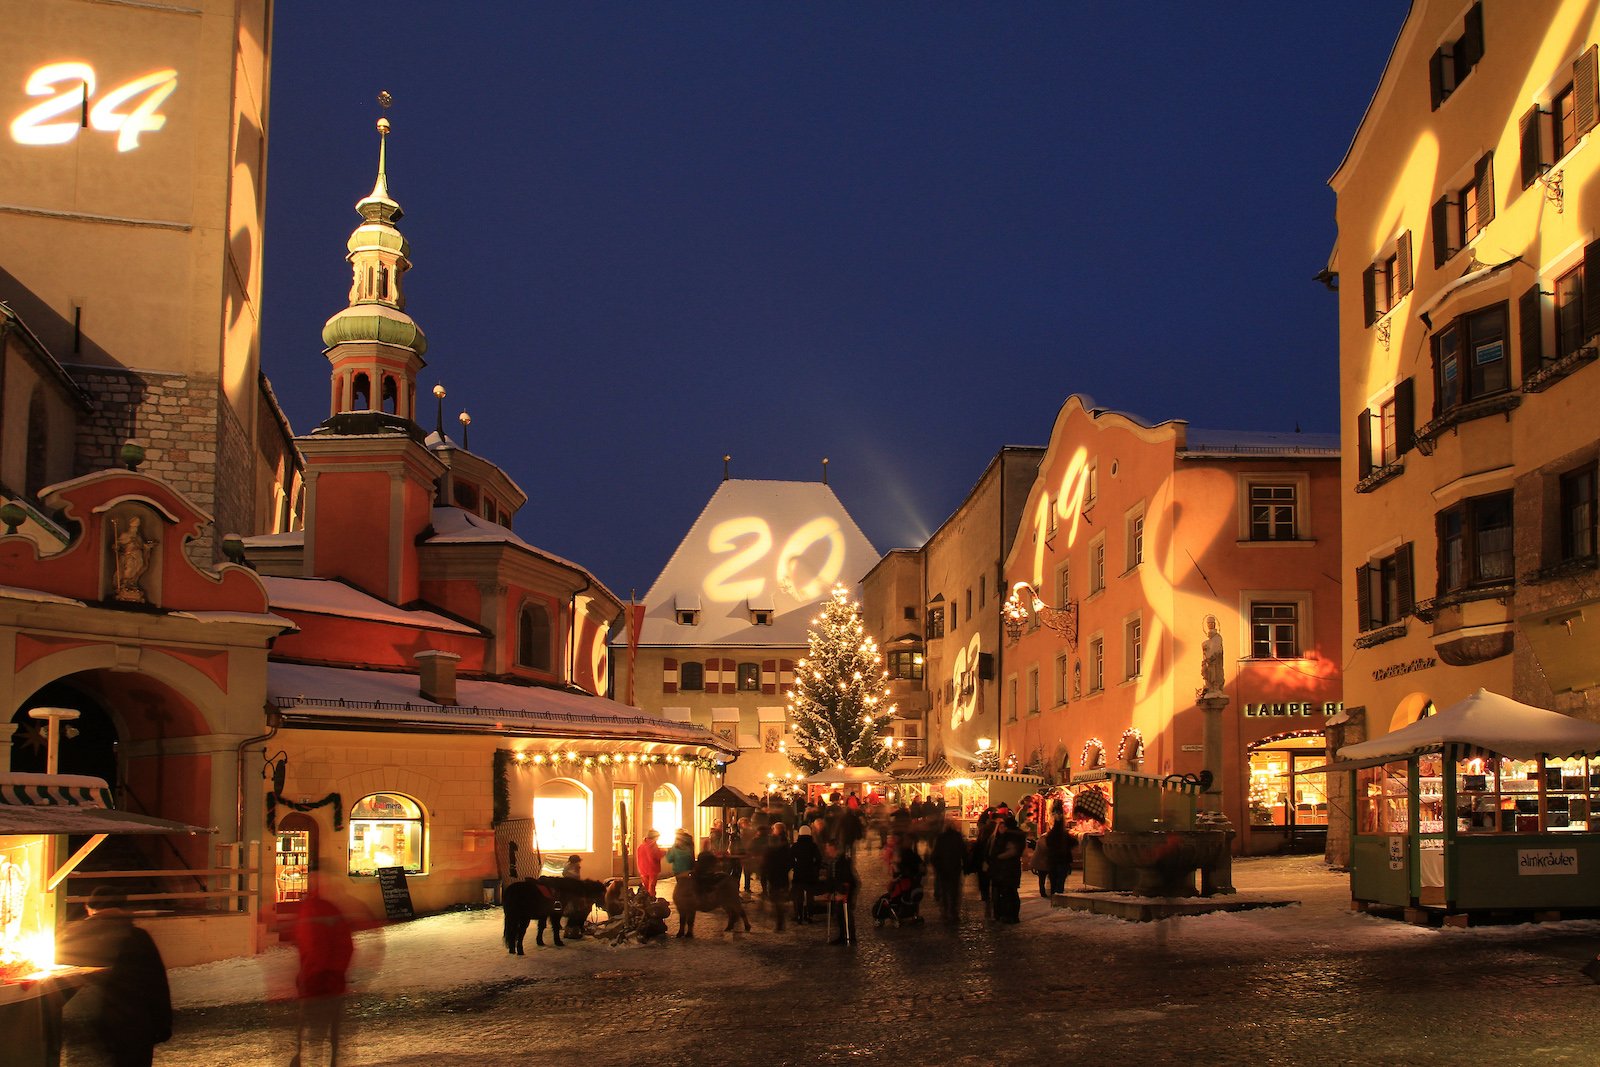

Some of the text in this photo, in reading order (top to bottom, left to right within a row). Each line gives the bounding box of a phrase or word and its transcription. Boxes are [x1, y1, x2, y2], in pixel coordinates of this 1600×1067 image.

[9, 60, 178, 152] 24
[703, 516, 846, 603] 20
[1034, 446, 1089, 587] 19
[951, 632, 981, 731] 23
[1245, 702, 1313, 717] LAMPE
